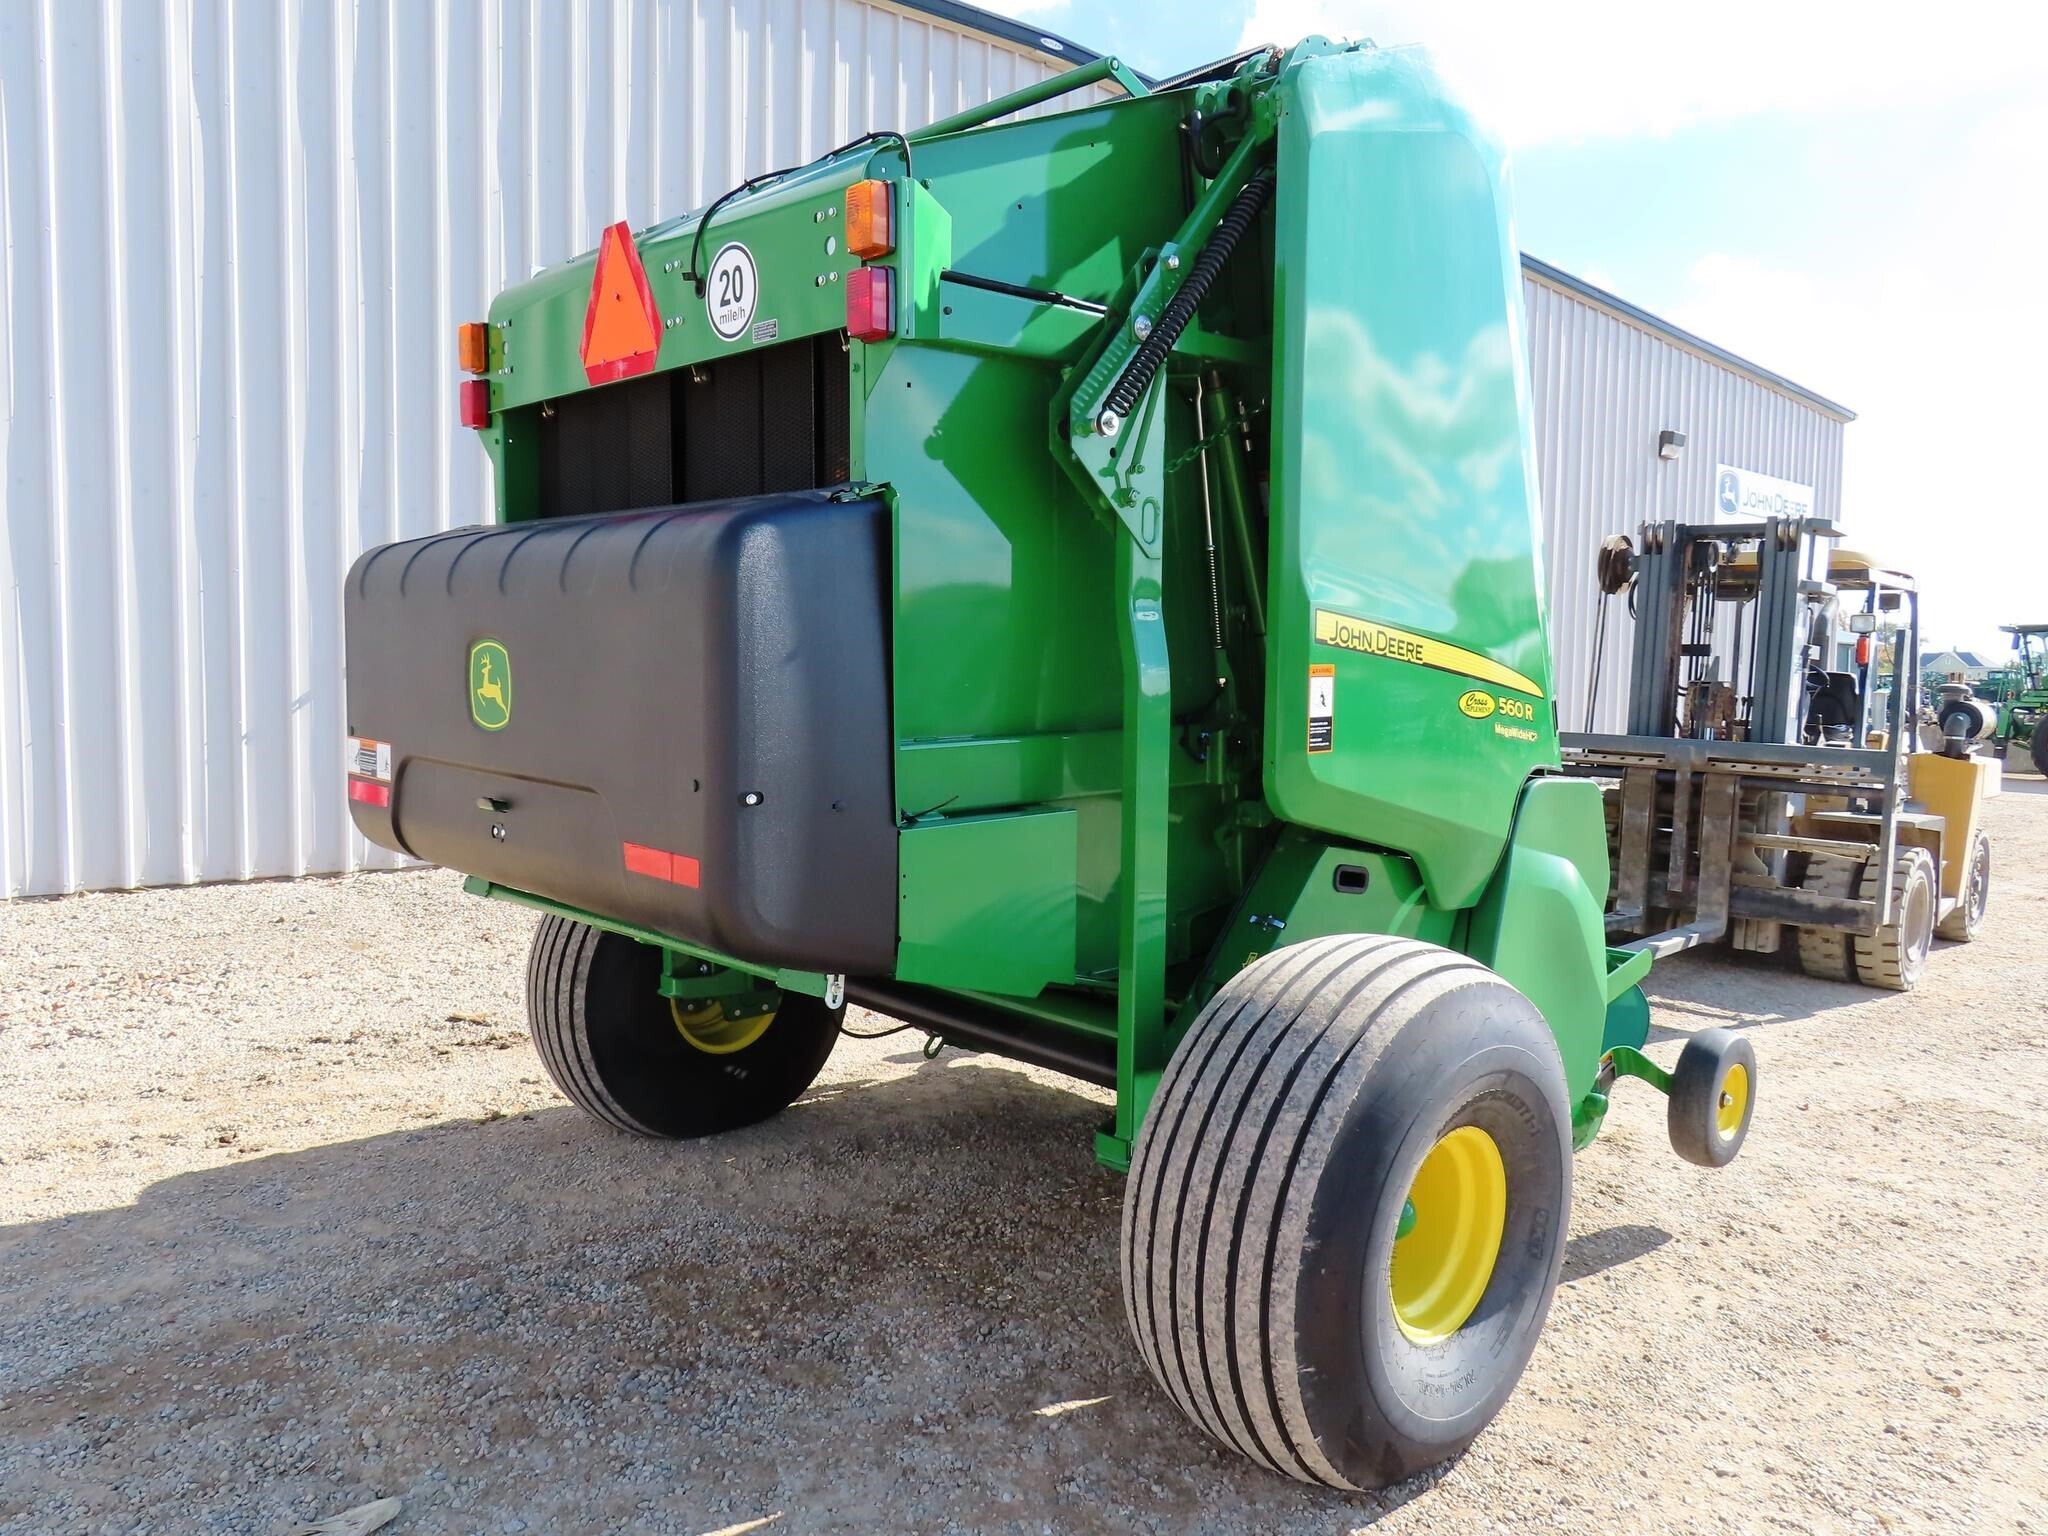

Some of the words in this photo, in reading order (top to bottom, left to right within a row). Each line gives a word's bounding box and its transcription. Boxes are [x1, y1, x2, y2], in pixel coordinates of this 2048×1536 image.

[719, 265, 744, 308] 20
[719, 306, 746, 325] mile/h
[1743, 487, 1773, 513] JOHN
[1329, 620, 1373, 649] JOHN
[1376, 630, 1424, 661] DEERE
[1466, 693, 1488, 707] Cross
